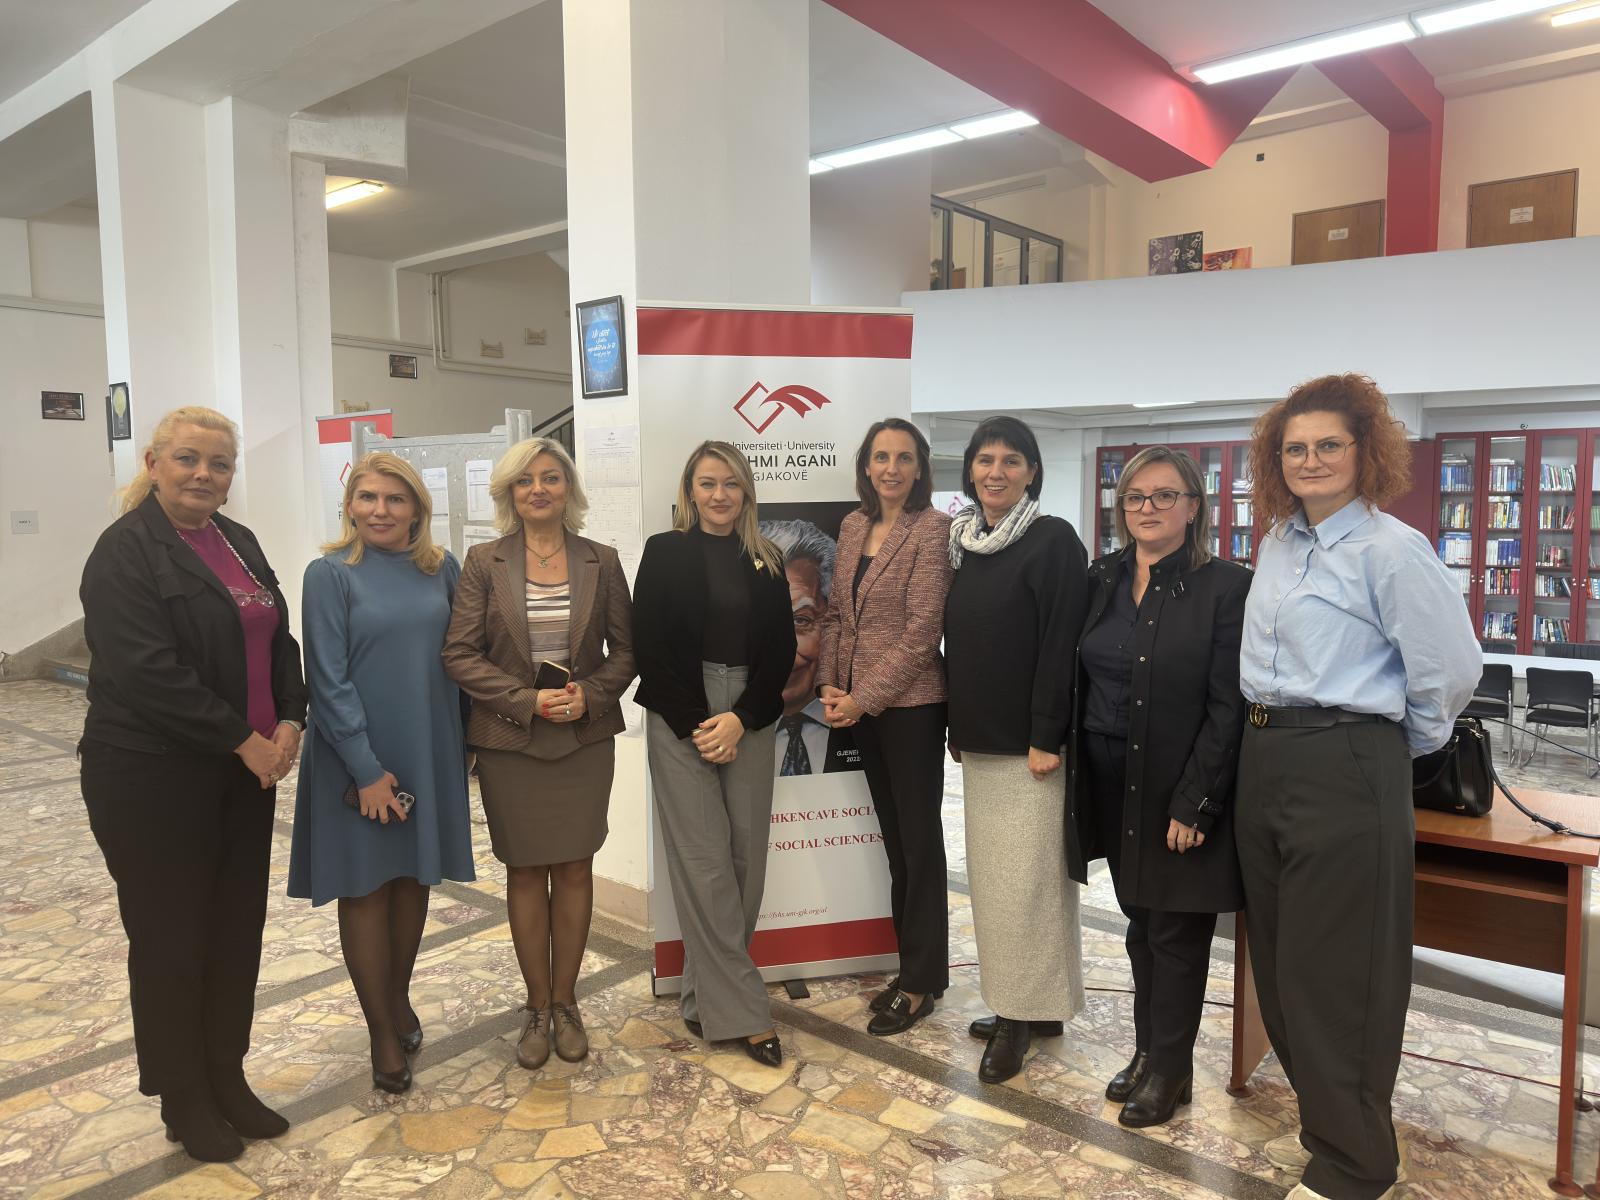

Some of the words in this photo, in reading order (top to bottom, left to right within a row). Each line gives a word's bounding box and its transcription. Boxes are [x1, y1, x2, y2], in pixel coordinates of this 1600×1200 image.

[787, 441, 836, 452] University
[747, 455, 778, 468] HMI
[785, 454, 837, 468] AGANI
[752, 469, 808, 481] GJAKOVË
[771, 808, 839, 824] HKENCAVE
[775, 838, 821, 852] SOCIAL
[824, 832, 884, 847] SCIENCES
